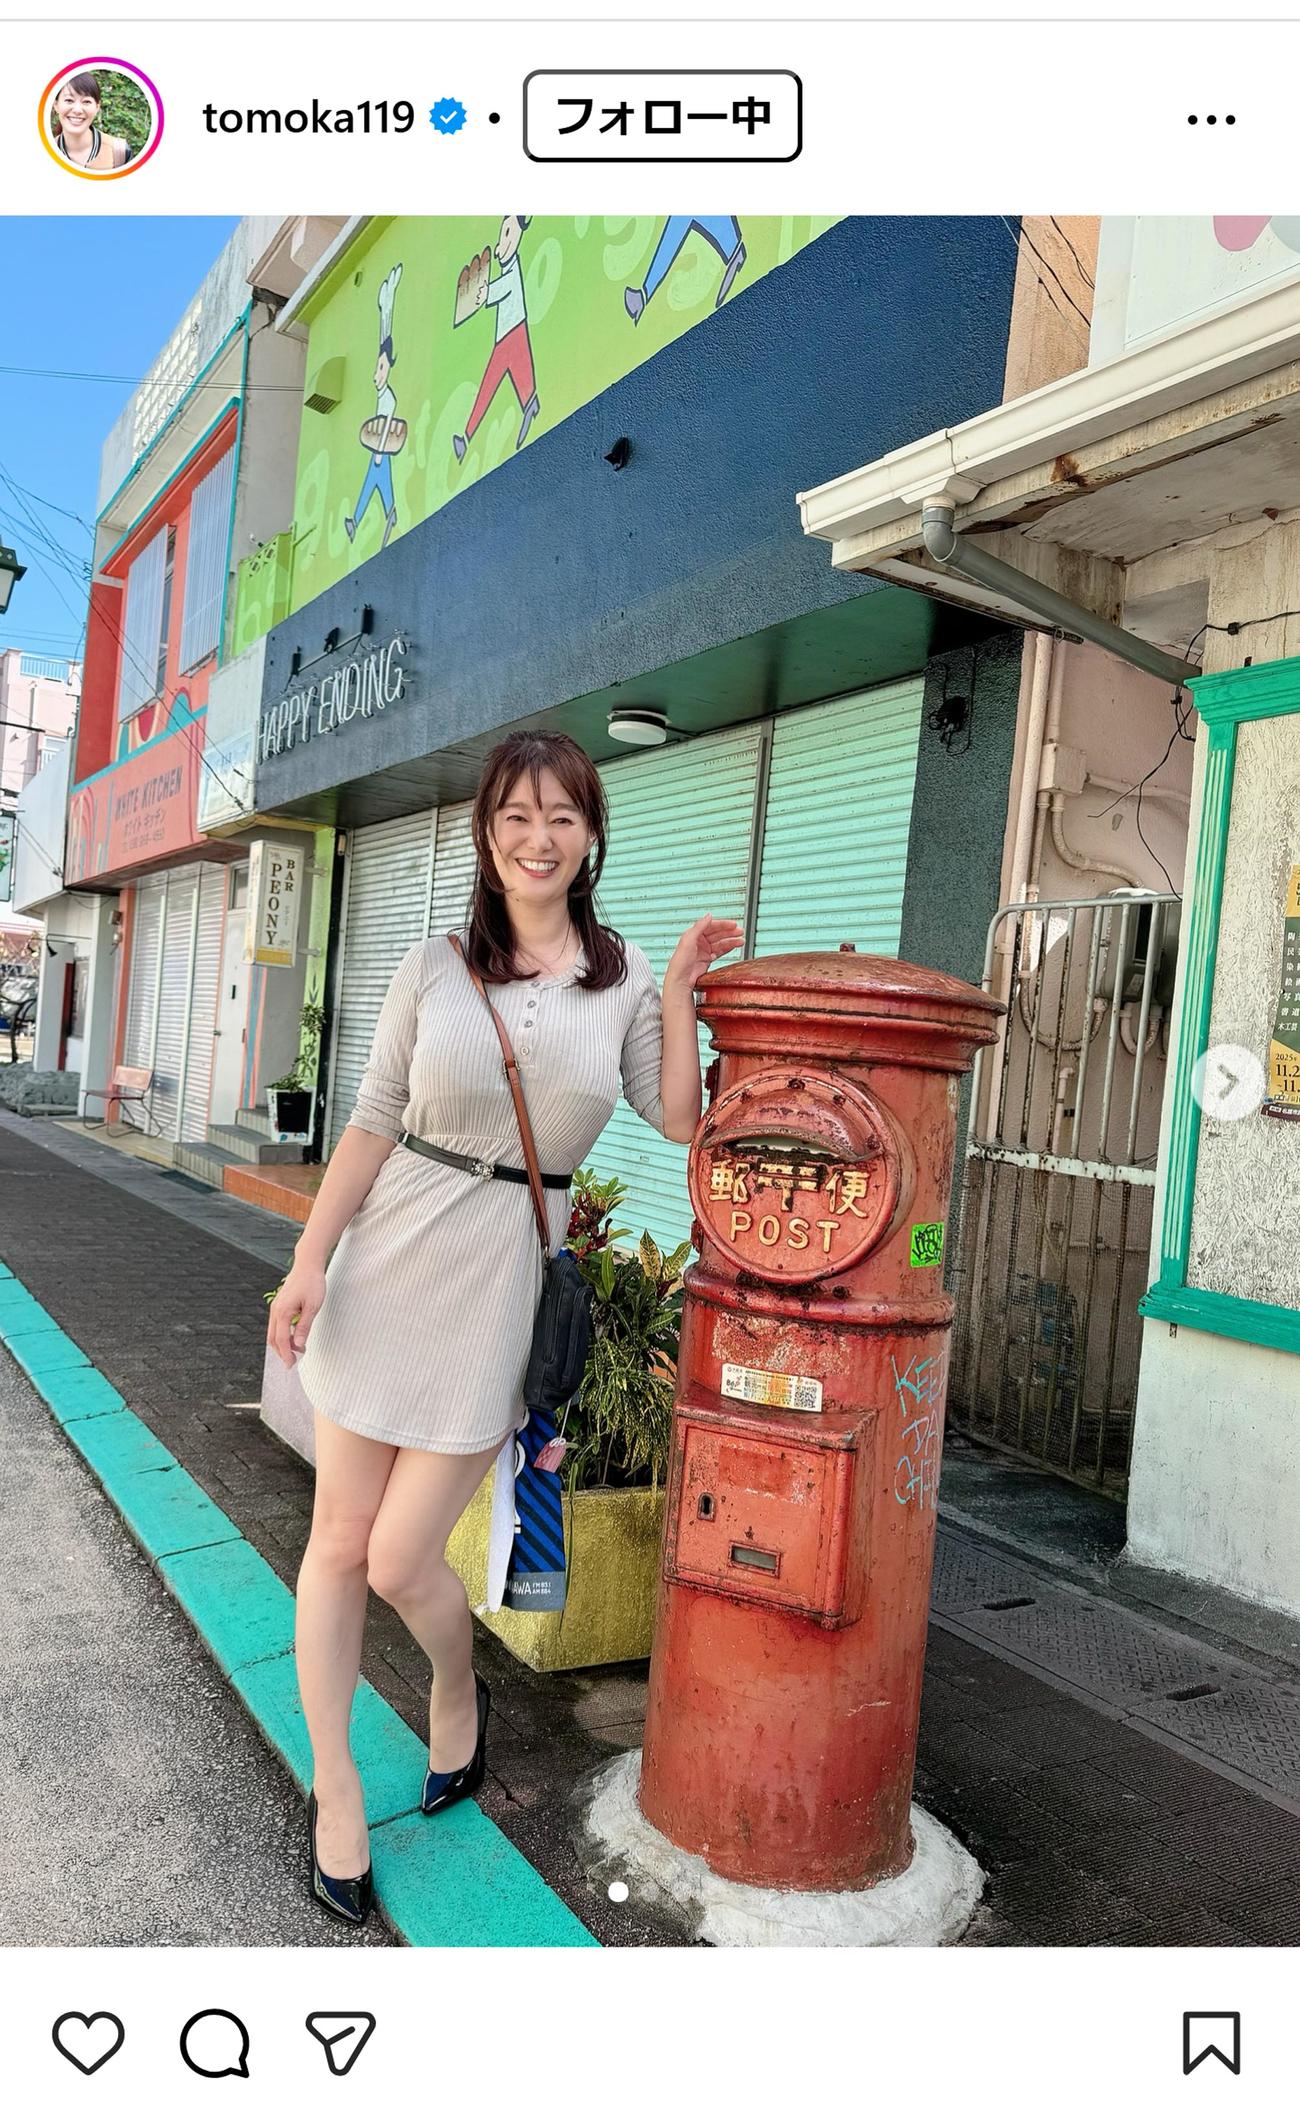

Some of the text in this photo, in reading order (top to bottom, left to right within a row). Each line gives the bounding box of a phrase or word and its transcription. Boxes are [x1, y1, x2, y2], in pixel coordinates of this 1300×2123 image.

[256, 638, 405, 764] HAPPY ENDING
[115, 787, 139, 822] WHITE
[141, 765, 183, 811] KITCHEN
[266, 862, 282, 945] PEONY
[285, 859, 295, 892] BAR
[729, 1211, 841, 1253] POST
